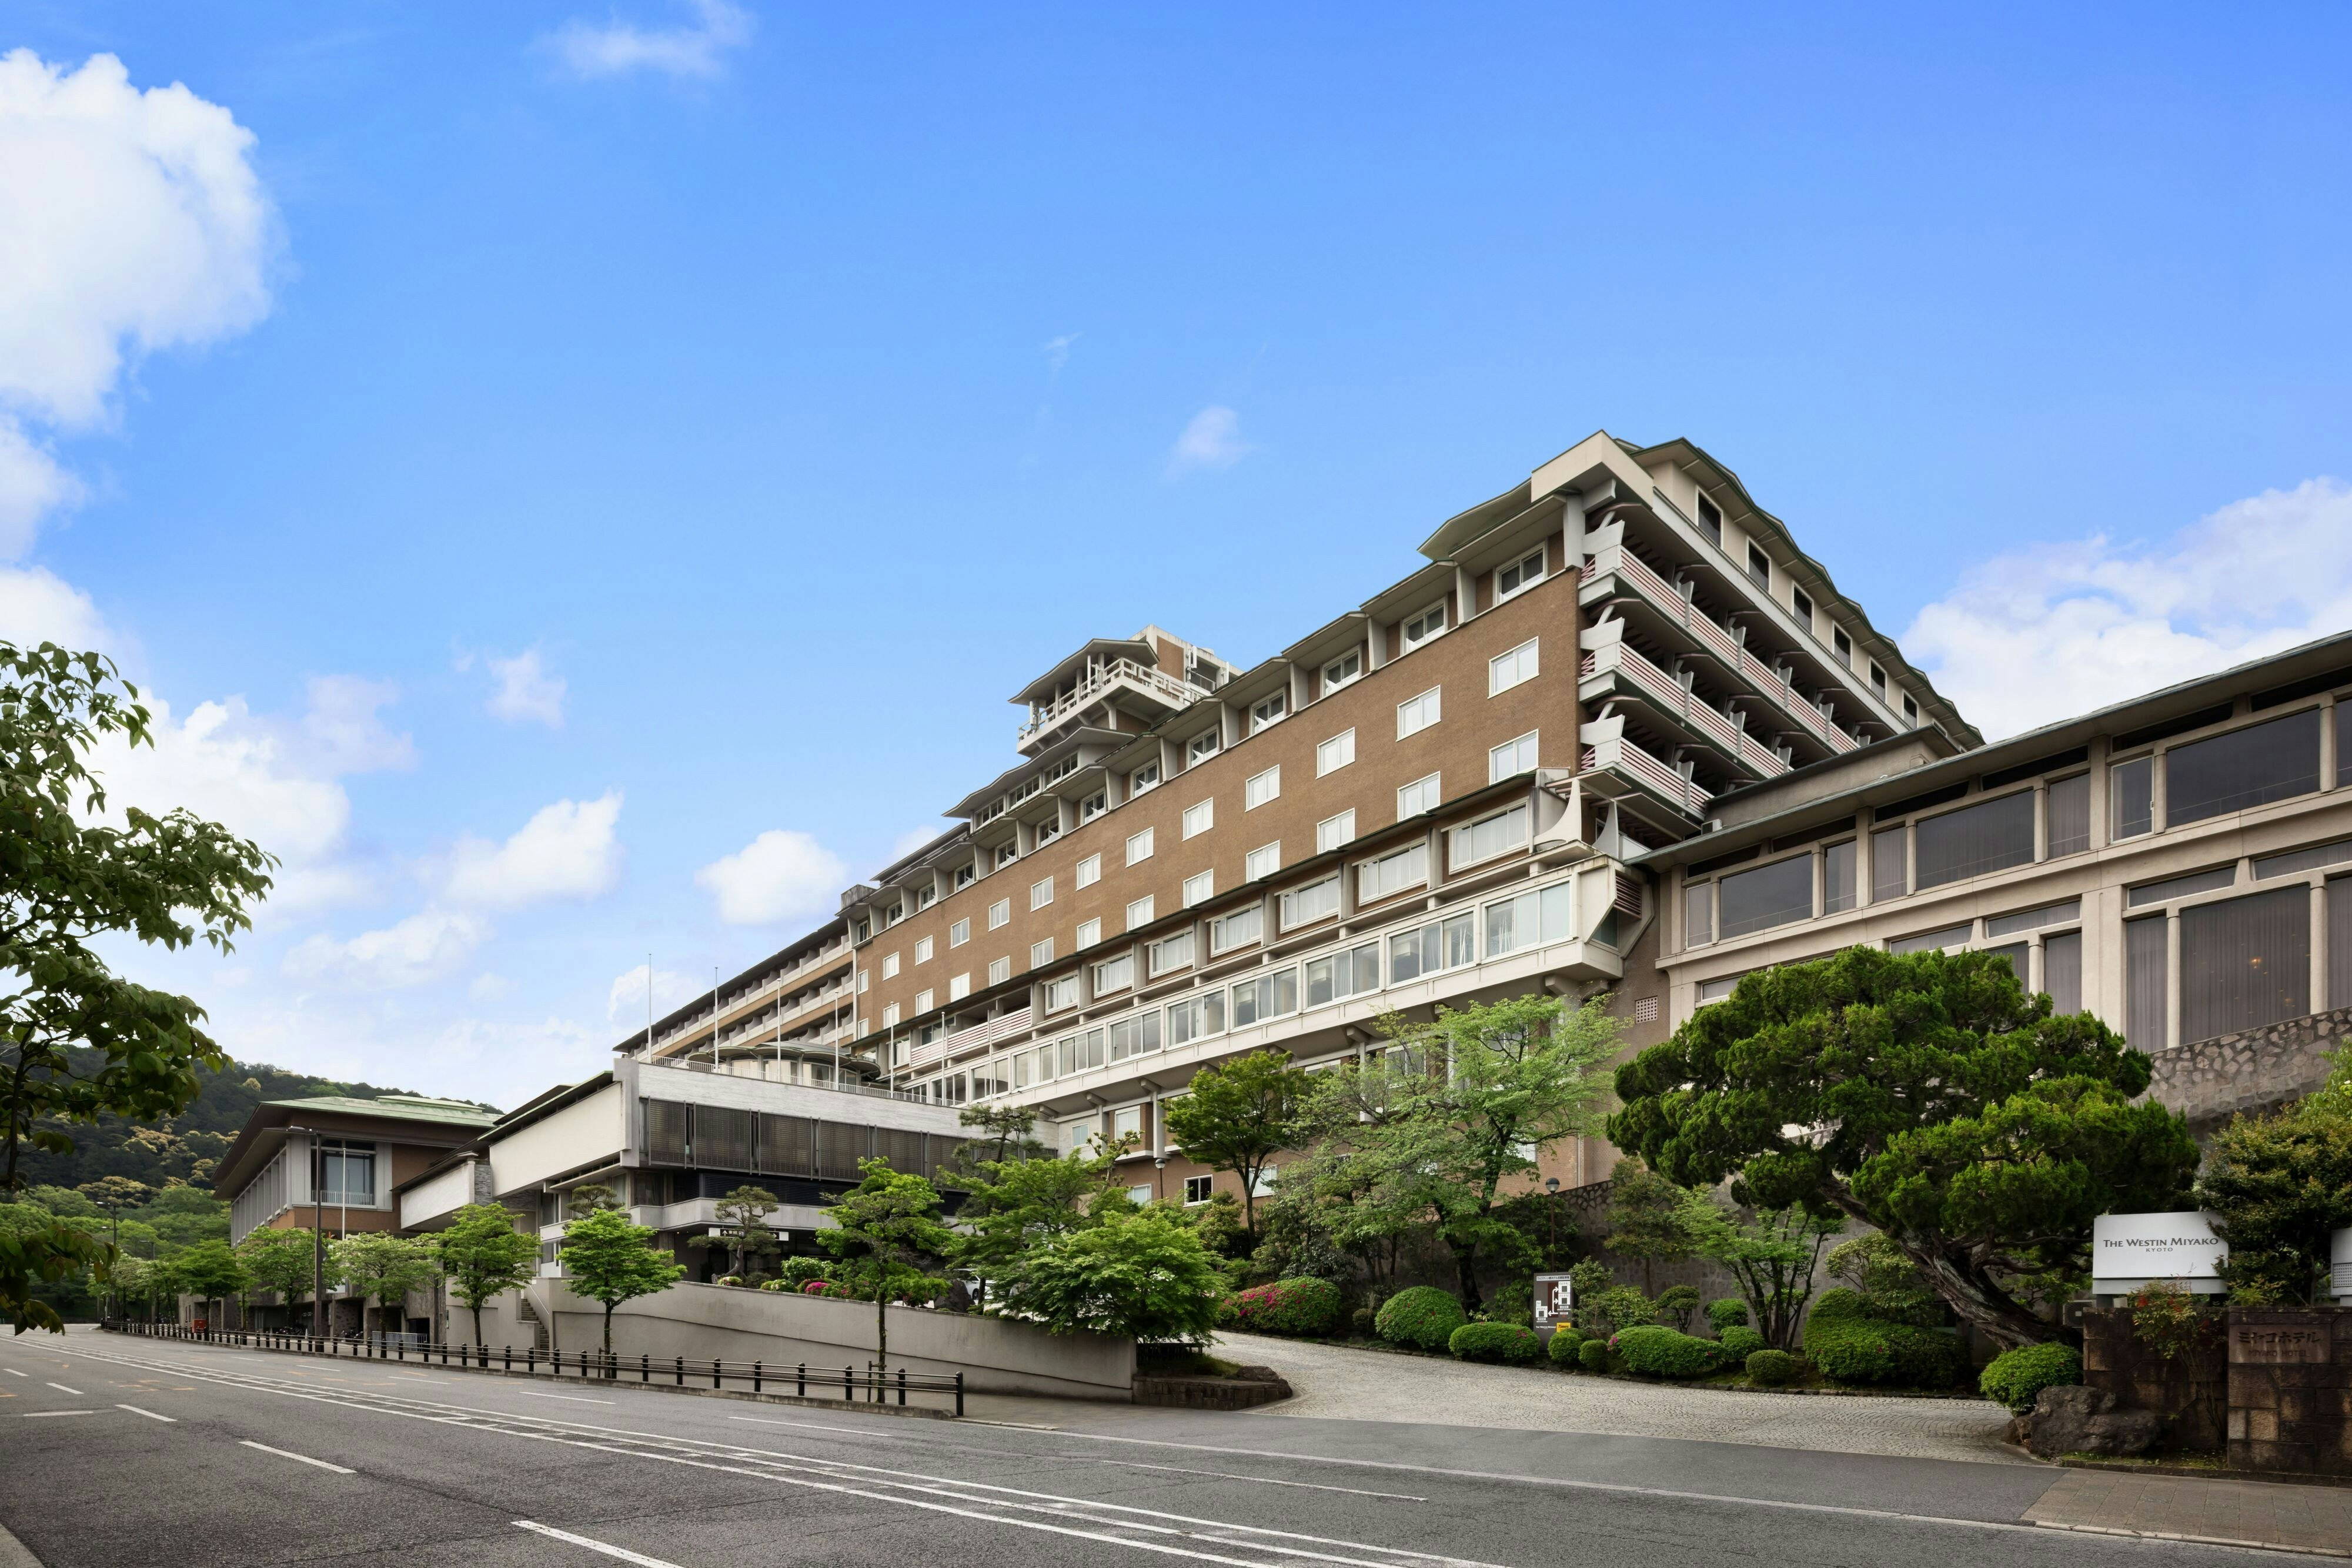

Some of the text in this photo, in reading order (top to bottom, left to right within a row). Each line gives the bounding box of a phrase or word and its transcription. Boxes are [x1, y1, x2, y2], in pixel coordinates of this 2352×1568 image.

[2170, 1238, 2219, 1246] MIYAKO
[2239, 1331, 2320, 1344] ミヤコホテル
